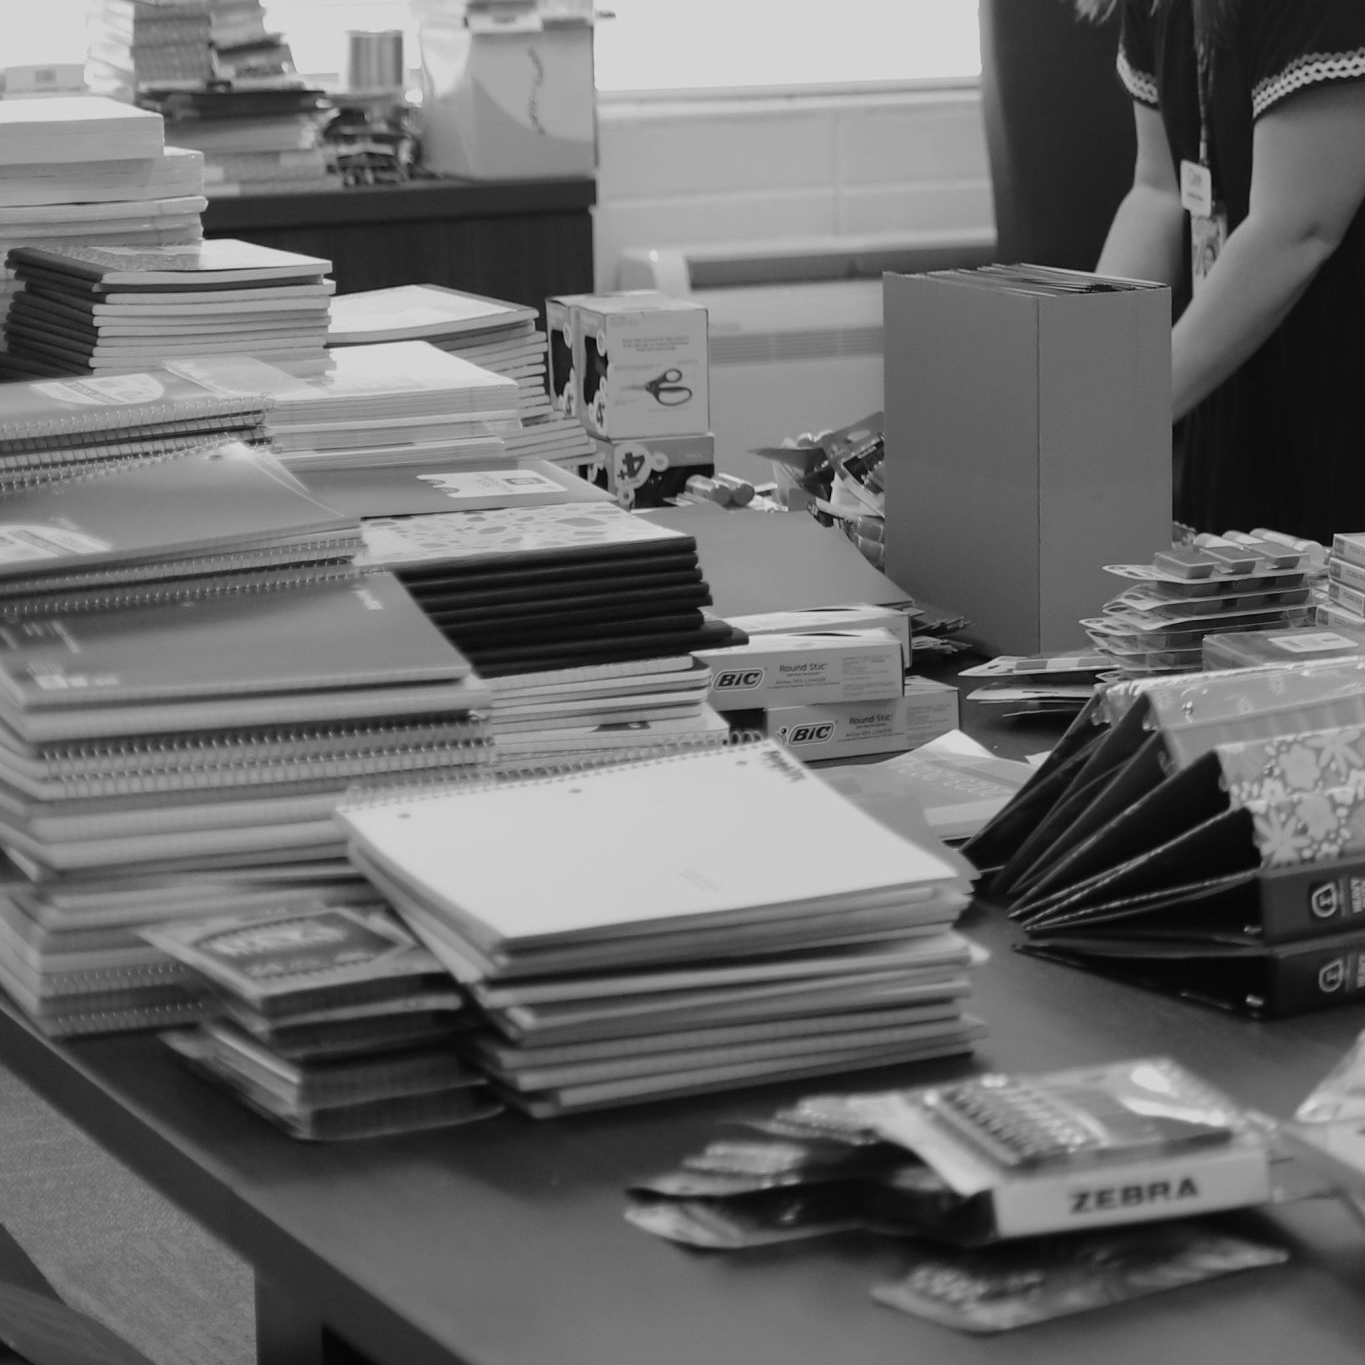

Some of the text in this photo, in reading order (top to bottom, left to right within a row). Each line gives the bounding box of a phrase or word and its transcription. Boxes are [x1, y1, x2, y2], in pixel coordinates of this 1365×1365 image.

[779, 663, 808, 673] Round
[717, 671, 761, 688] BIC
[849, 715, 875, 725] Round
[791, 724, 832, 743] BIC
[1068, 1176, 1200, 1215] ZEBRA
